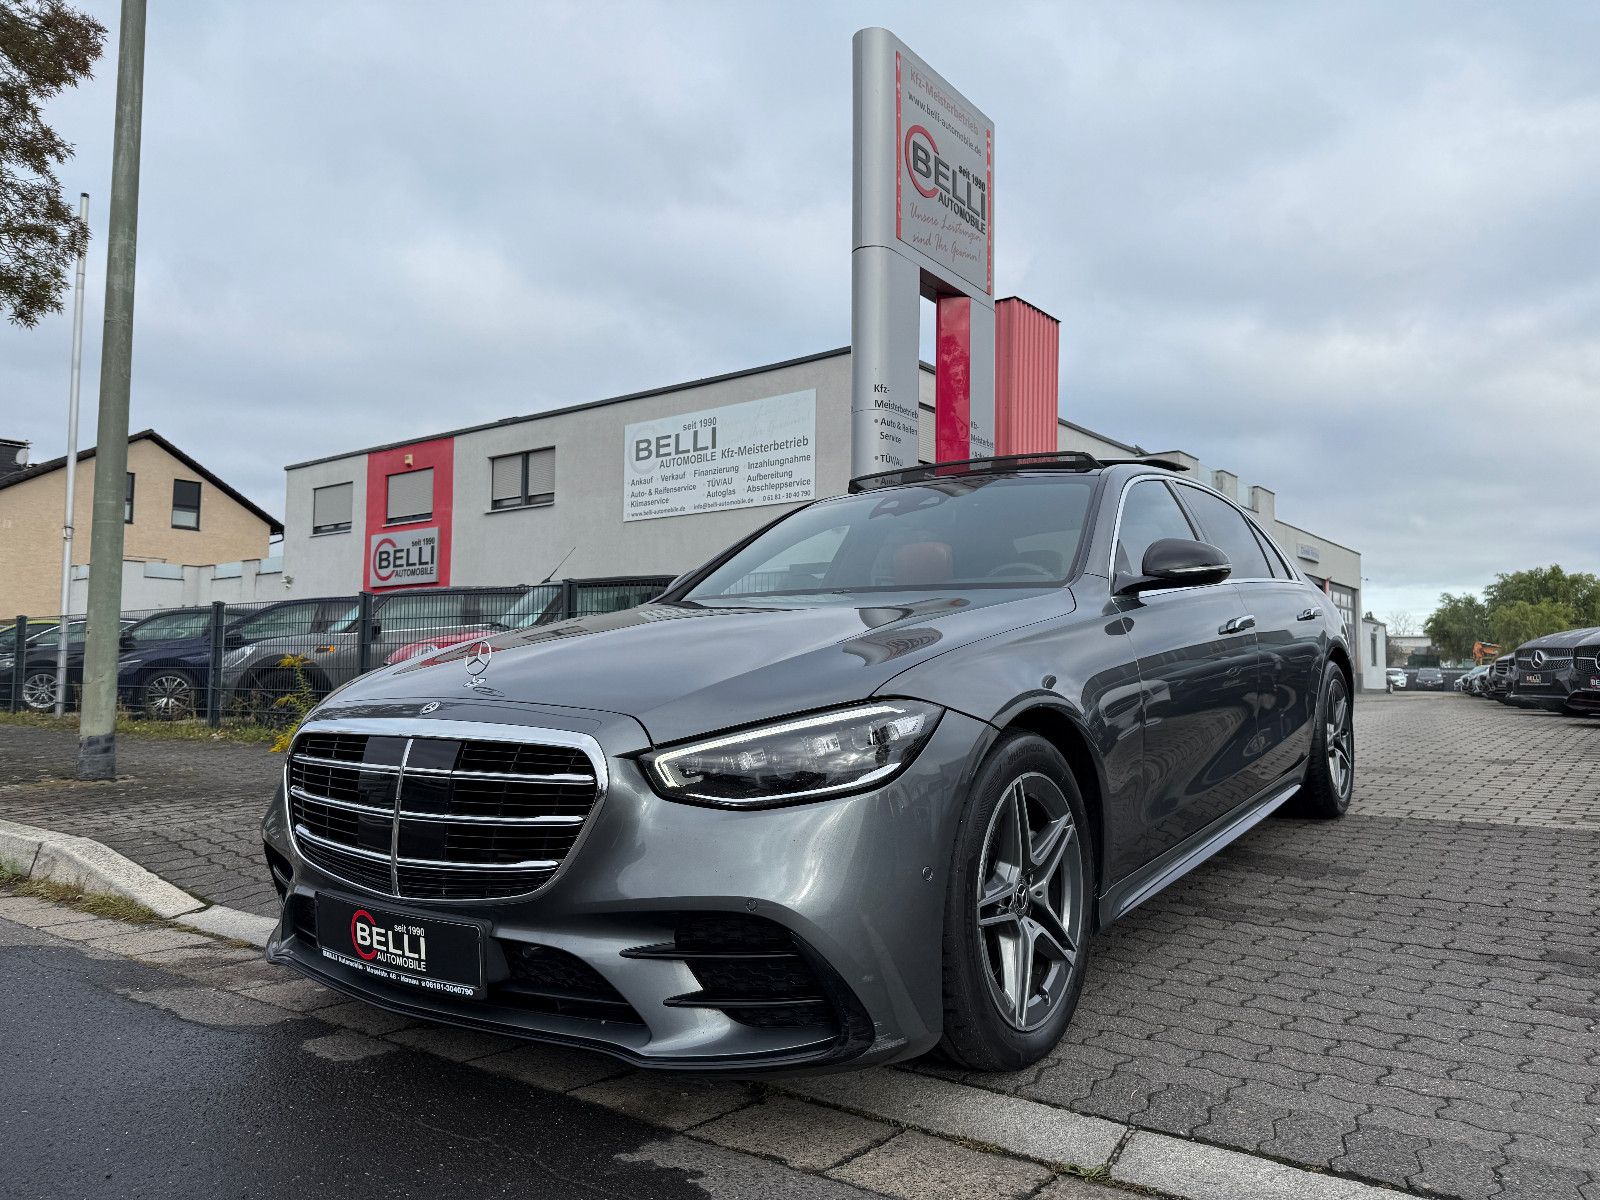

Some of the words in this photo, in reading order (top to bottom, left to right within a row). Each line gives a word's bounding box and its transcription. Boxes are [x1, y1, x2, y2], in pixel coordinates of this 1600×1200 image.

[908, 91, 982, 156] www.belli-automobile.de
[913, 140, 986, 221] BELLI
[959, 165, 971, 181] seit
[972, 174, 986, 192] 1990
[938, 192, 986, 235] AUTOMOBILE
[874, 384, 890, 393] Kfz-
[874, 400, 919, 419] Meisterbetrieb
[683, 421, 697, 431] seit
[699, 417, 717, 428] 1990
[635, 427, 717, 461] BELLI
[721, 435, 809, 459] Kfz-Meisterbetrieb
[880, 432, 901, 443] Service
[630, 476, 654, 486] Ankauf
[660, 472, 686, 482] Verkauf
[693, 465, 740, 478] Finanzierung
[747, 454, 811, 470] Inzahlungnahme
[660, 451, 717, 469] AUTOMOBILE
[630, 489, 648, 498] Auto-
[648, 488, 653, 496] &
[654, 484, 697, 495] Reifenservice
[746, 470, 793, 482] Aufbereitung
[630, 497, 670, 508] Klimaservice
[706, 487, 736, 499] Autoglas
[746, 478, 811, 493] Abschleppservice
[630, 505, 686, 517] www.belli-automobile.de
[693, 498, 754, 510] info@belli-automobile.de
[411, 538, 421, 547] seit
[423, 537, 436, 545] 1990
[378, 545, 435, 569] BELLI
[395, 567, 434, 577] AUTOMOBILE
[356, 922, 426, 960] BELLI
[394, 924, 406, 934] seit
[407, 925, 425, 937] 1990
[377, 952, 427, 972] AUTOMOBILE
[426, 980, 474, 996] 06181-3040790
